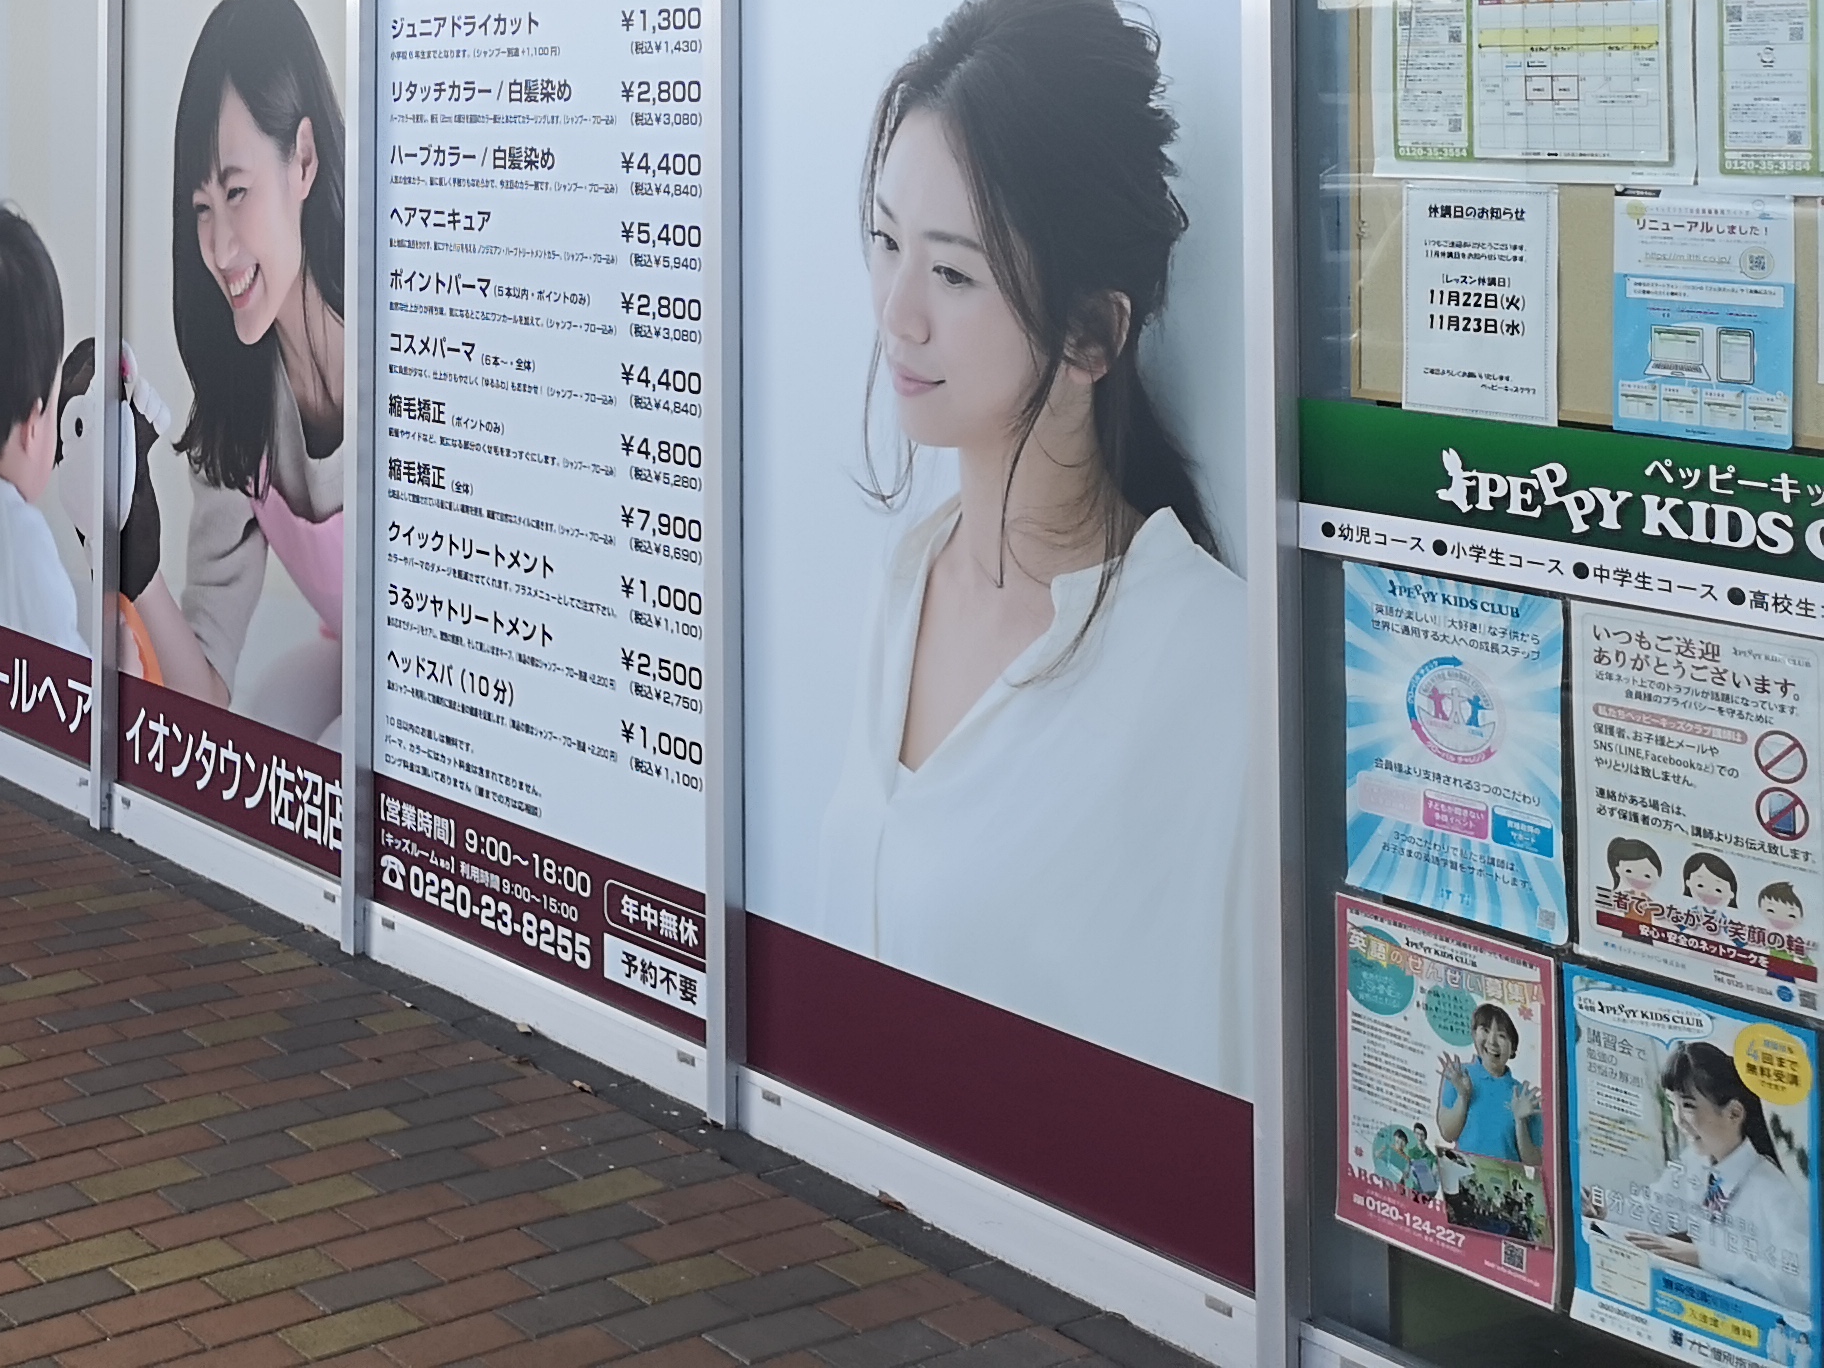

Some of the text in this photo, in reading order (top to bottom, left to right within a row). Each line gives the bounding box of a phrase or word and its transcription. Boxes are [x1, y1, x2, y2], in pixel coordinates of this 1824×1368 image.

[391, 11, 539, 40] ジュニアドライカット
[622, 7, 702, 32] ¥1,300
[622, 80, 702, 104] ¥2,800
[622, 152, 702, 177] ¥4,400
[390, 205, 492, 233] ヘアマニキュア
[1428, 203, 1526, 222] 休講日のお知らせ
[622, 220, 702, 249] ¥5,400
[390, 269, 492, 299] ポイントパーマ
[1430, 289, 1526, 312] 11月22日(火)
[622, 291, 702, 322] ¥2,800
[1429, 314, 1526, 337] 11月23日(水)
[390, 333, 476, 362] コスメパーマ
[622, 362, 702, 395] ¥4,400
[388, 393, 446, 425] 縮毛矯正
[622, 433, 702, 469] ¥4,800
[388, 456, 446, 490] 縮毛矯正
[622, 504, 702, 543] ¥7,900
[1477, 462, 1633, 533] PEPPY
[1641, 495, 1793, 555] KIDS
[388, 520, 554, 579] クイックトリートメント
[1338, 523, 1824, 622] 幼児コース 小学生コース 中学生コース 高校生
[622, 575, 702, 616] ¥1,000
[1397, 583, 1520, 618] PEPPY KIDS CLUB
[387, 582, 553, 647] うるツヤトリートメント
[1593, 624, 1721, 663] いつもご送迎
[622, 647, 702, 691] ¥2,500
[1593, 646, 1800, 702] ありがとうございます。
[622, 719, 702, 766] ¥1,000
[1593, 722, 1720, 757] 保護者、お子様とメールや
[125, 707, 342, 852] イオンタウン佐沼店
[1594, 757, 1697, 788] やりとりは致しません。
[1595, 786, 1687, 817] 連絡がある場合は、
[409, 865, 592, 970] 0220-23-8255
[620, 894, 699, 948] 年中無休
[621, 951, 698, 1006] 予約不要
[1641, 1010, 1670, 1022] KIDS
[1672, 1015, 1704, 1028] CLUB
[1366, 1197, 1466, 1248] 0120-124-227
